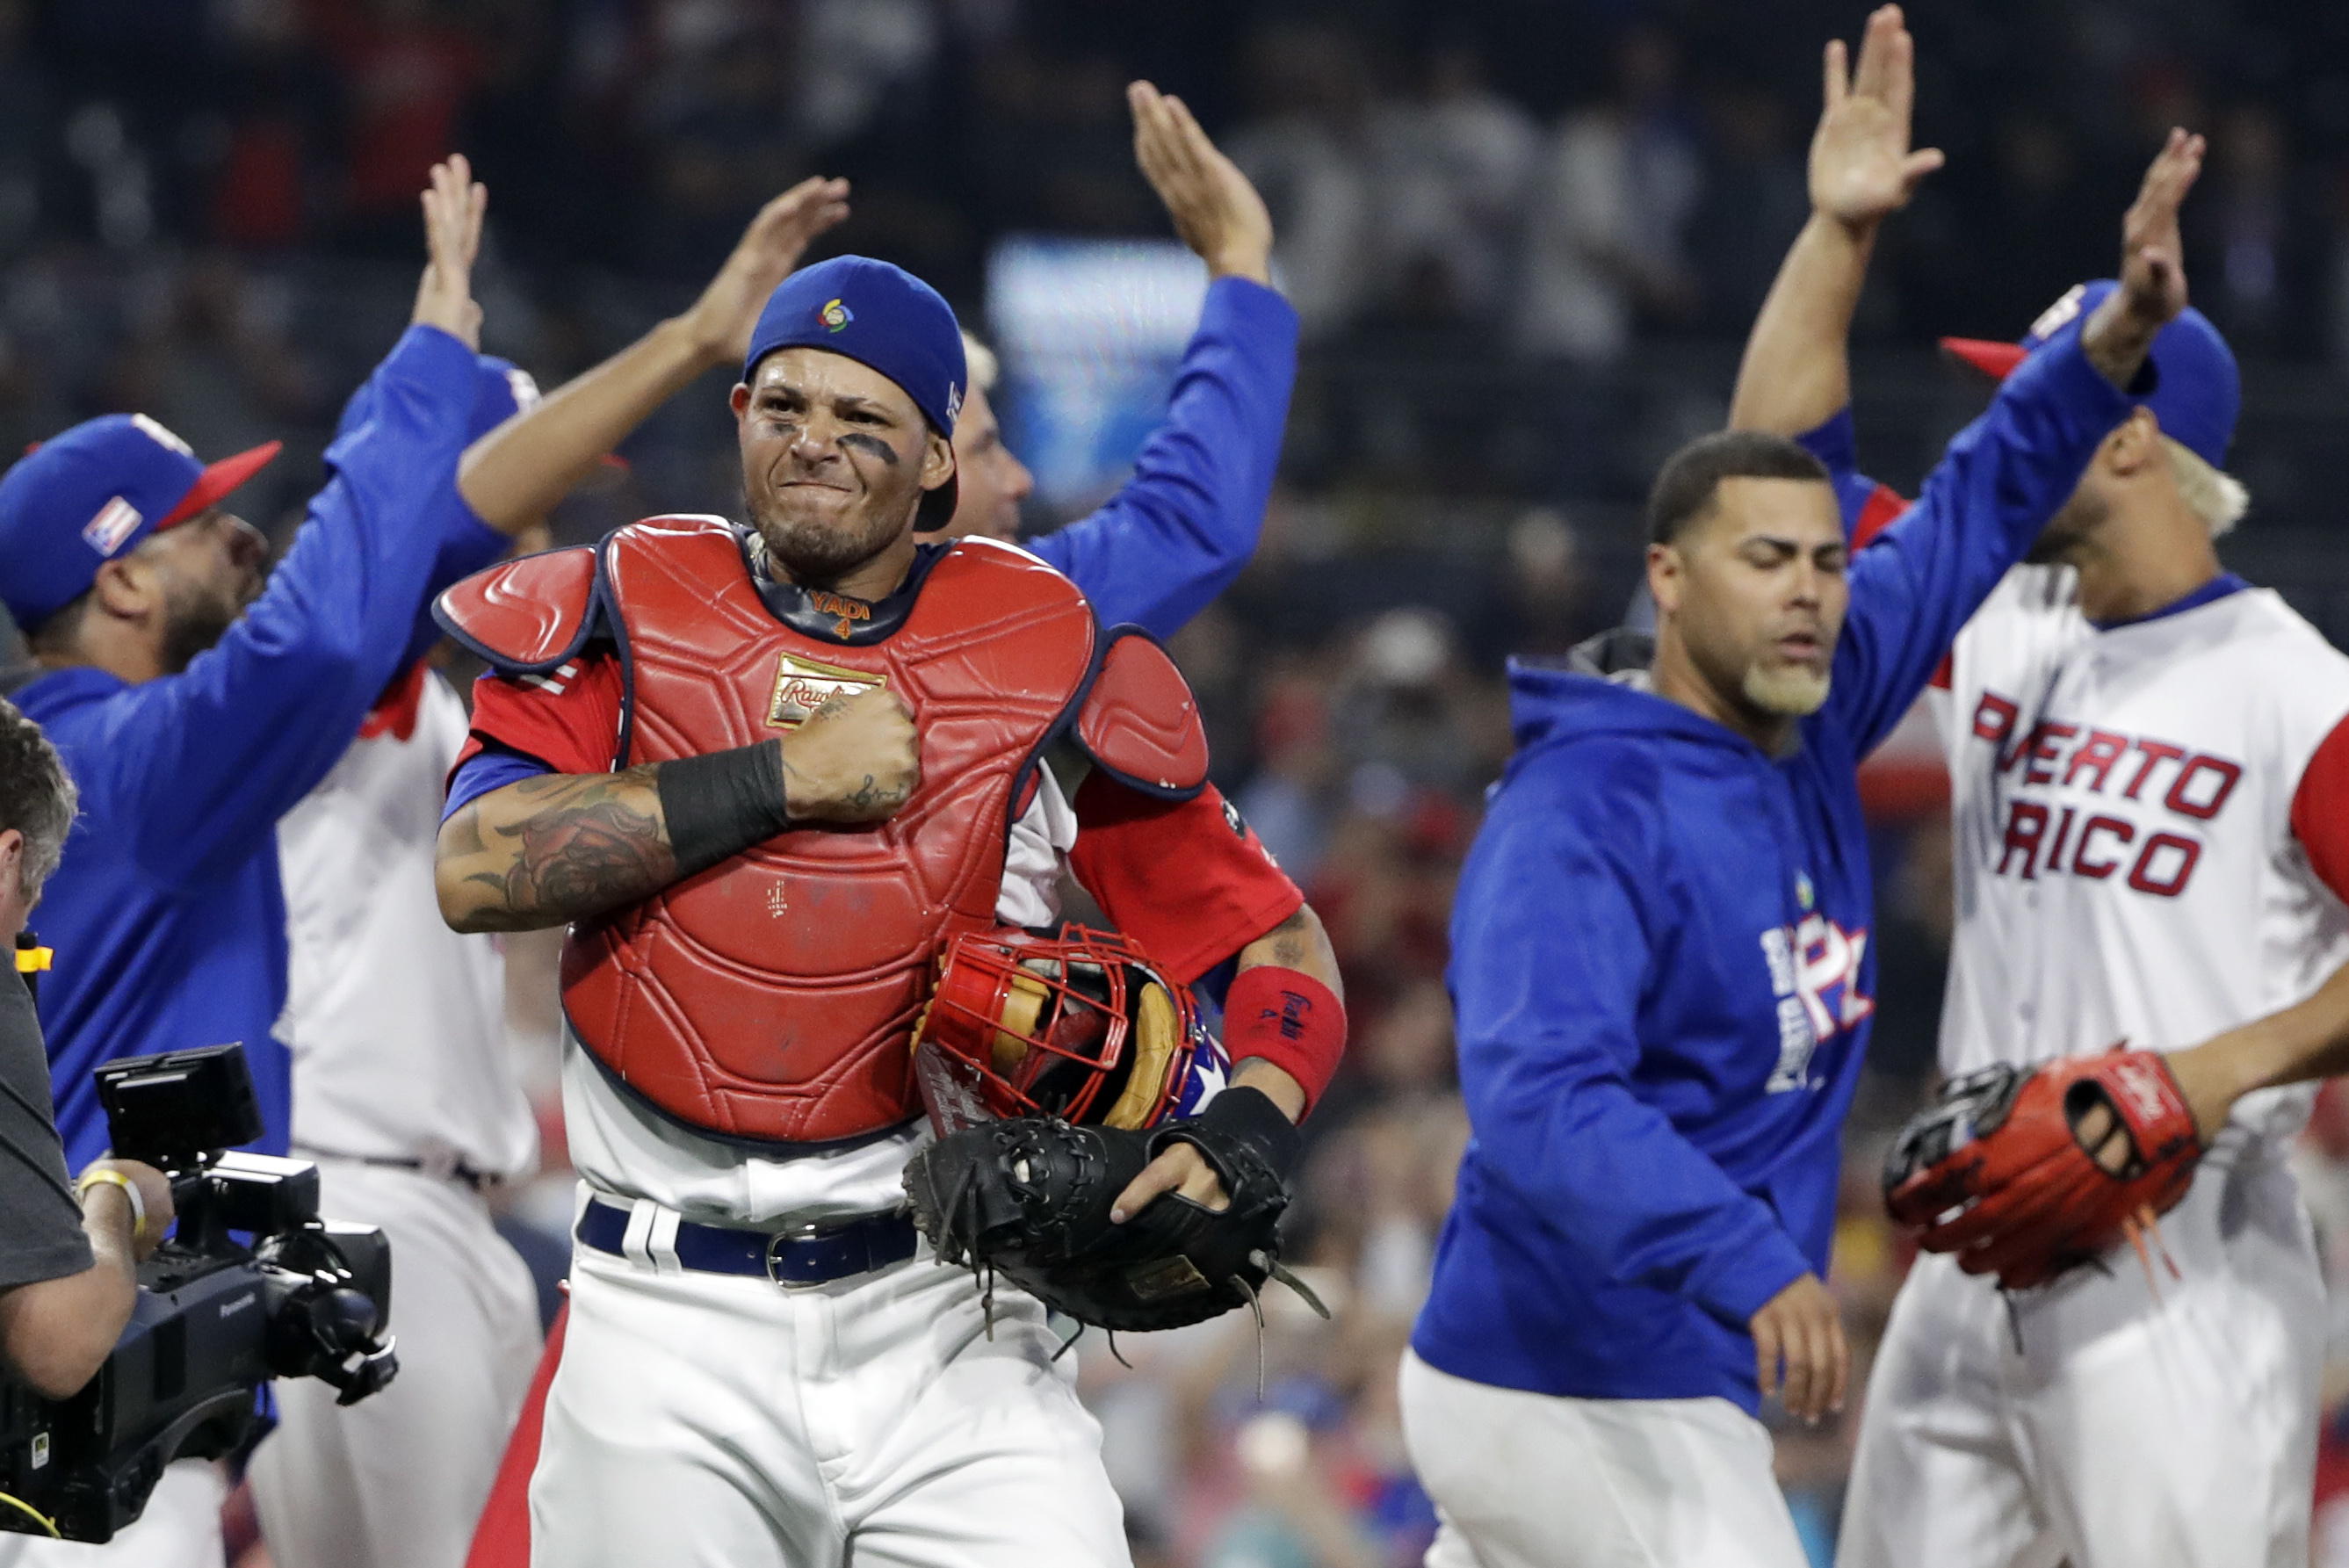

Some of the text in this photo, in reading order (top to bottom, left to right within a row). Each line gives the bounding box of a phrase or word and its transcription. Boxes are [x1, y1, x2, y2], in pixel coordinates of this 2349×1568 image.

[811, 590, 871, 620] YADI
[833, 618, 851, 639] 4
[780, 679, 844, 710] Rawl
[1973, 691, 2243, 820] PERTO
[1997, 798, 2201, 897] RICO
